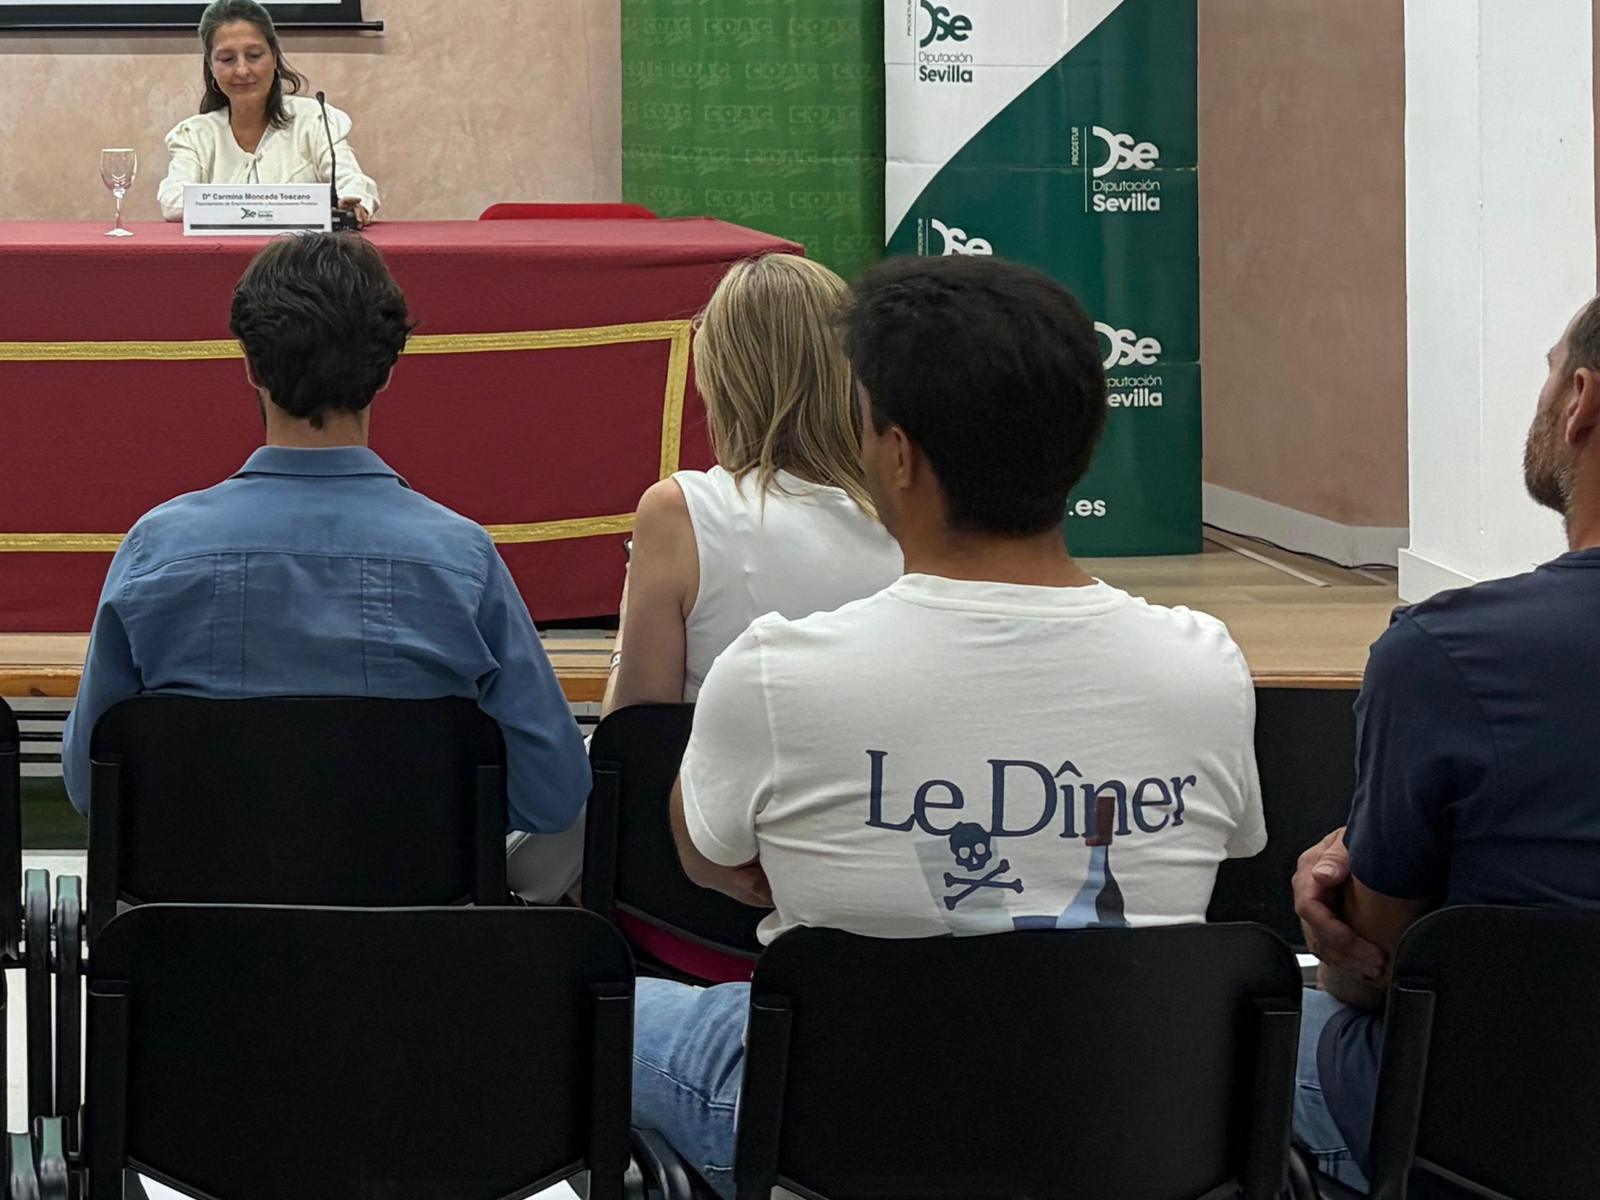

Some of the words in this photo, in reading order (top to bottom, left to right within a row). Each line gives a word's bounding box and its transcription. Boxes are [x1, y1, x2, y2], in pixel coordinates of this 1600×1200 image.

[919, 51, 973, 65] Diputación
[919, 65, 973, 82] Sevilla
[1093, 179, 1160, 194] Diputación
[1093, 193, 1160, 212] Sevilla
[1107, 374, 1162, 388] putación
[1107, 388, 1163, 407] evilla
[865, 750, 964, 836] Le
[987, 759, 1197, 838] Dîner
